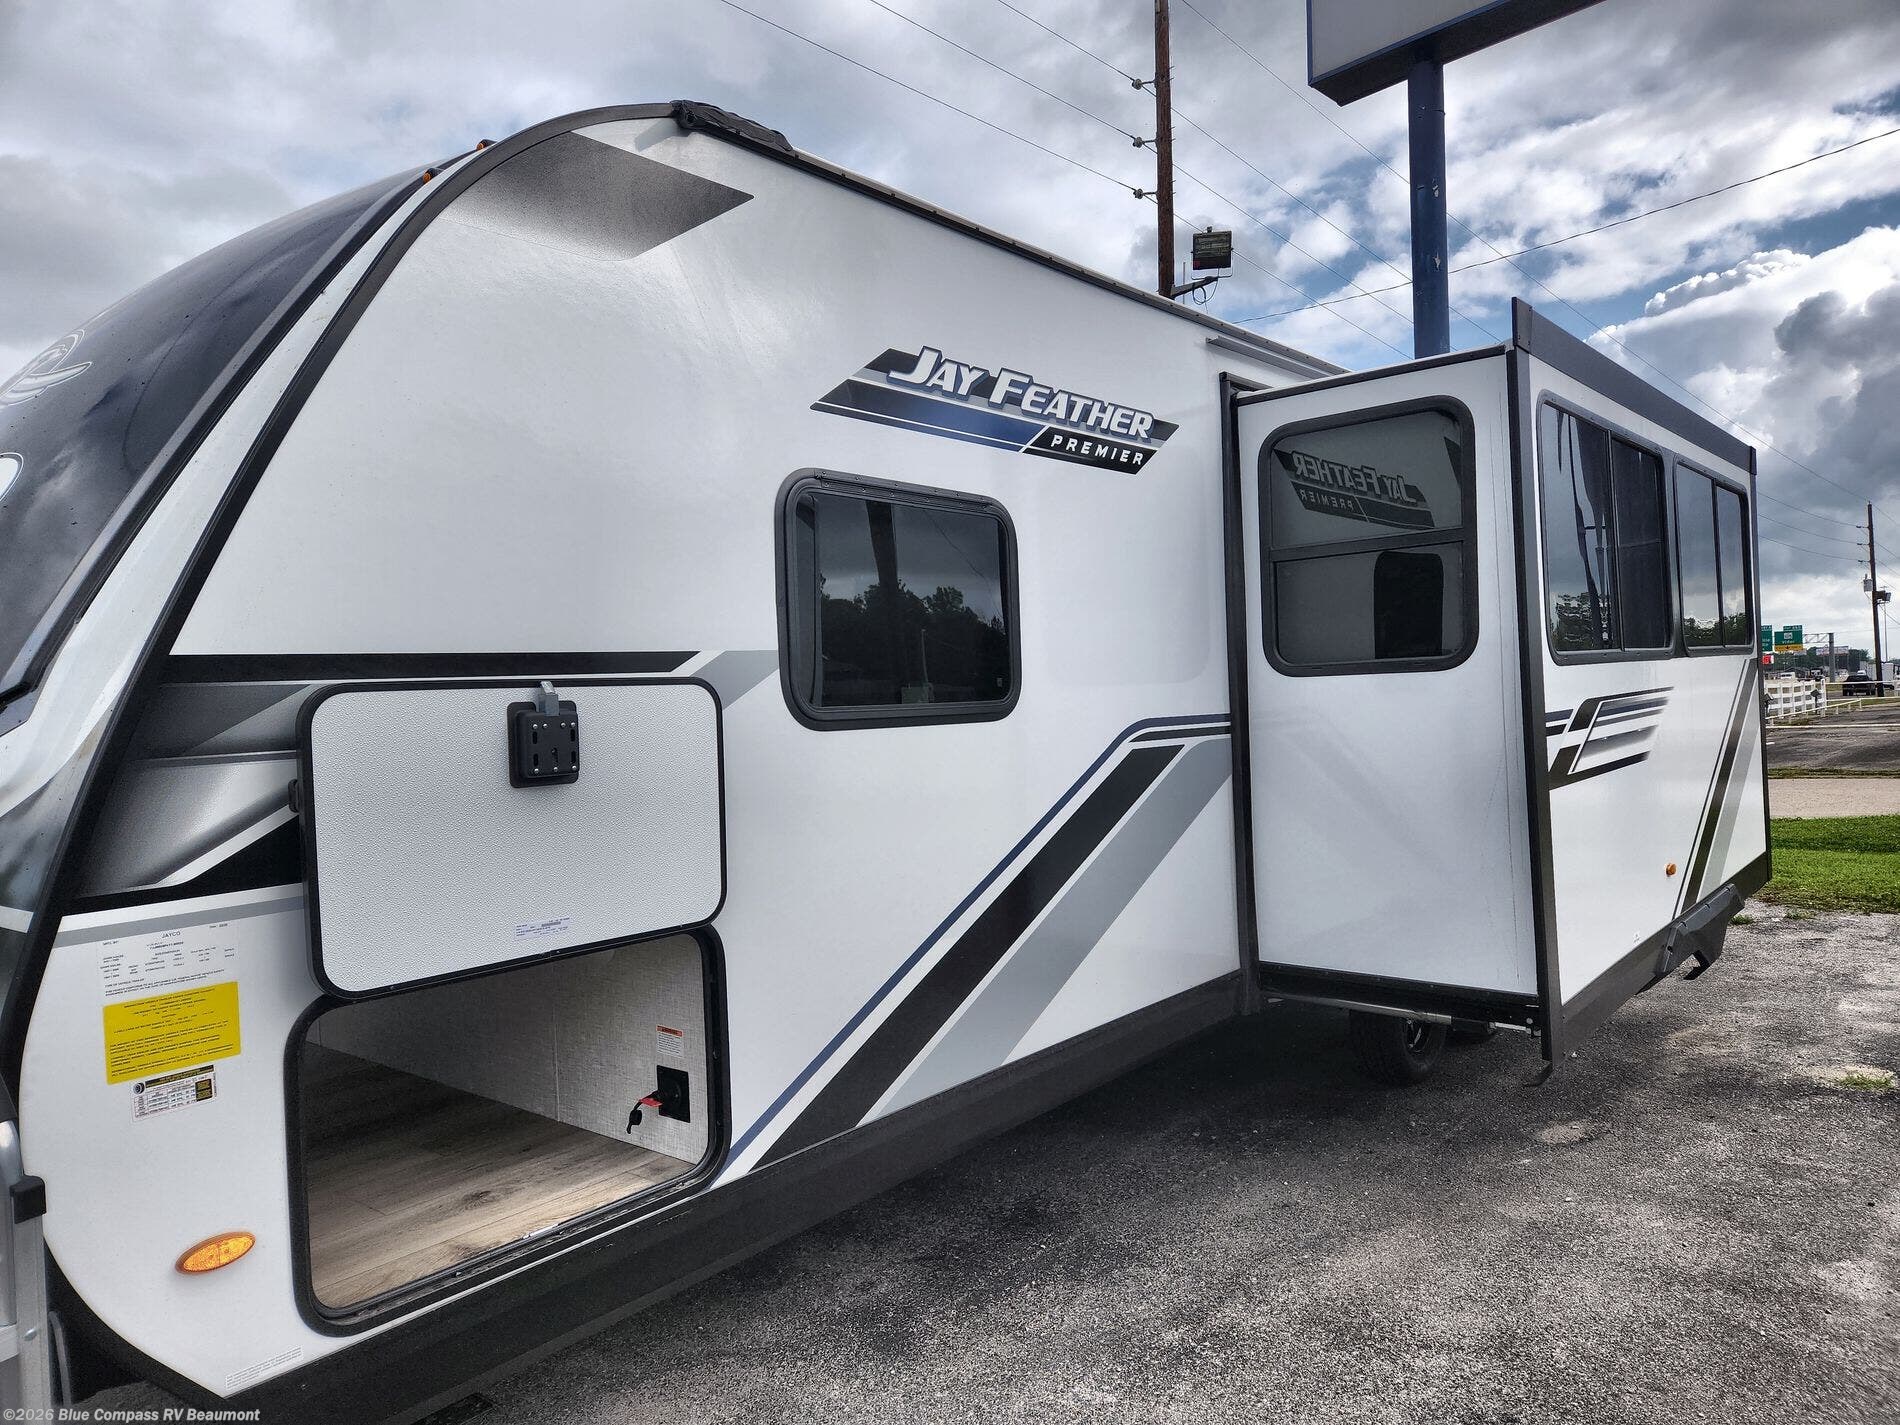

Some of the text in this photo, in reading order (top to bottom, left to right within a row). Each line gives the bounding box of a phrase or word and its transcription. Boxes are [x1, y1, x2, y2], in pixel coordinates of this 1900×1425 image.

[888, 346, 1156, 441] JAY FEATHER
[1051, 434, 1144, 466] PREMIER
[161, 931, 181, 939] JAYCO
